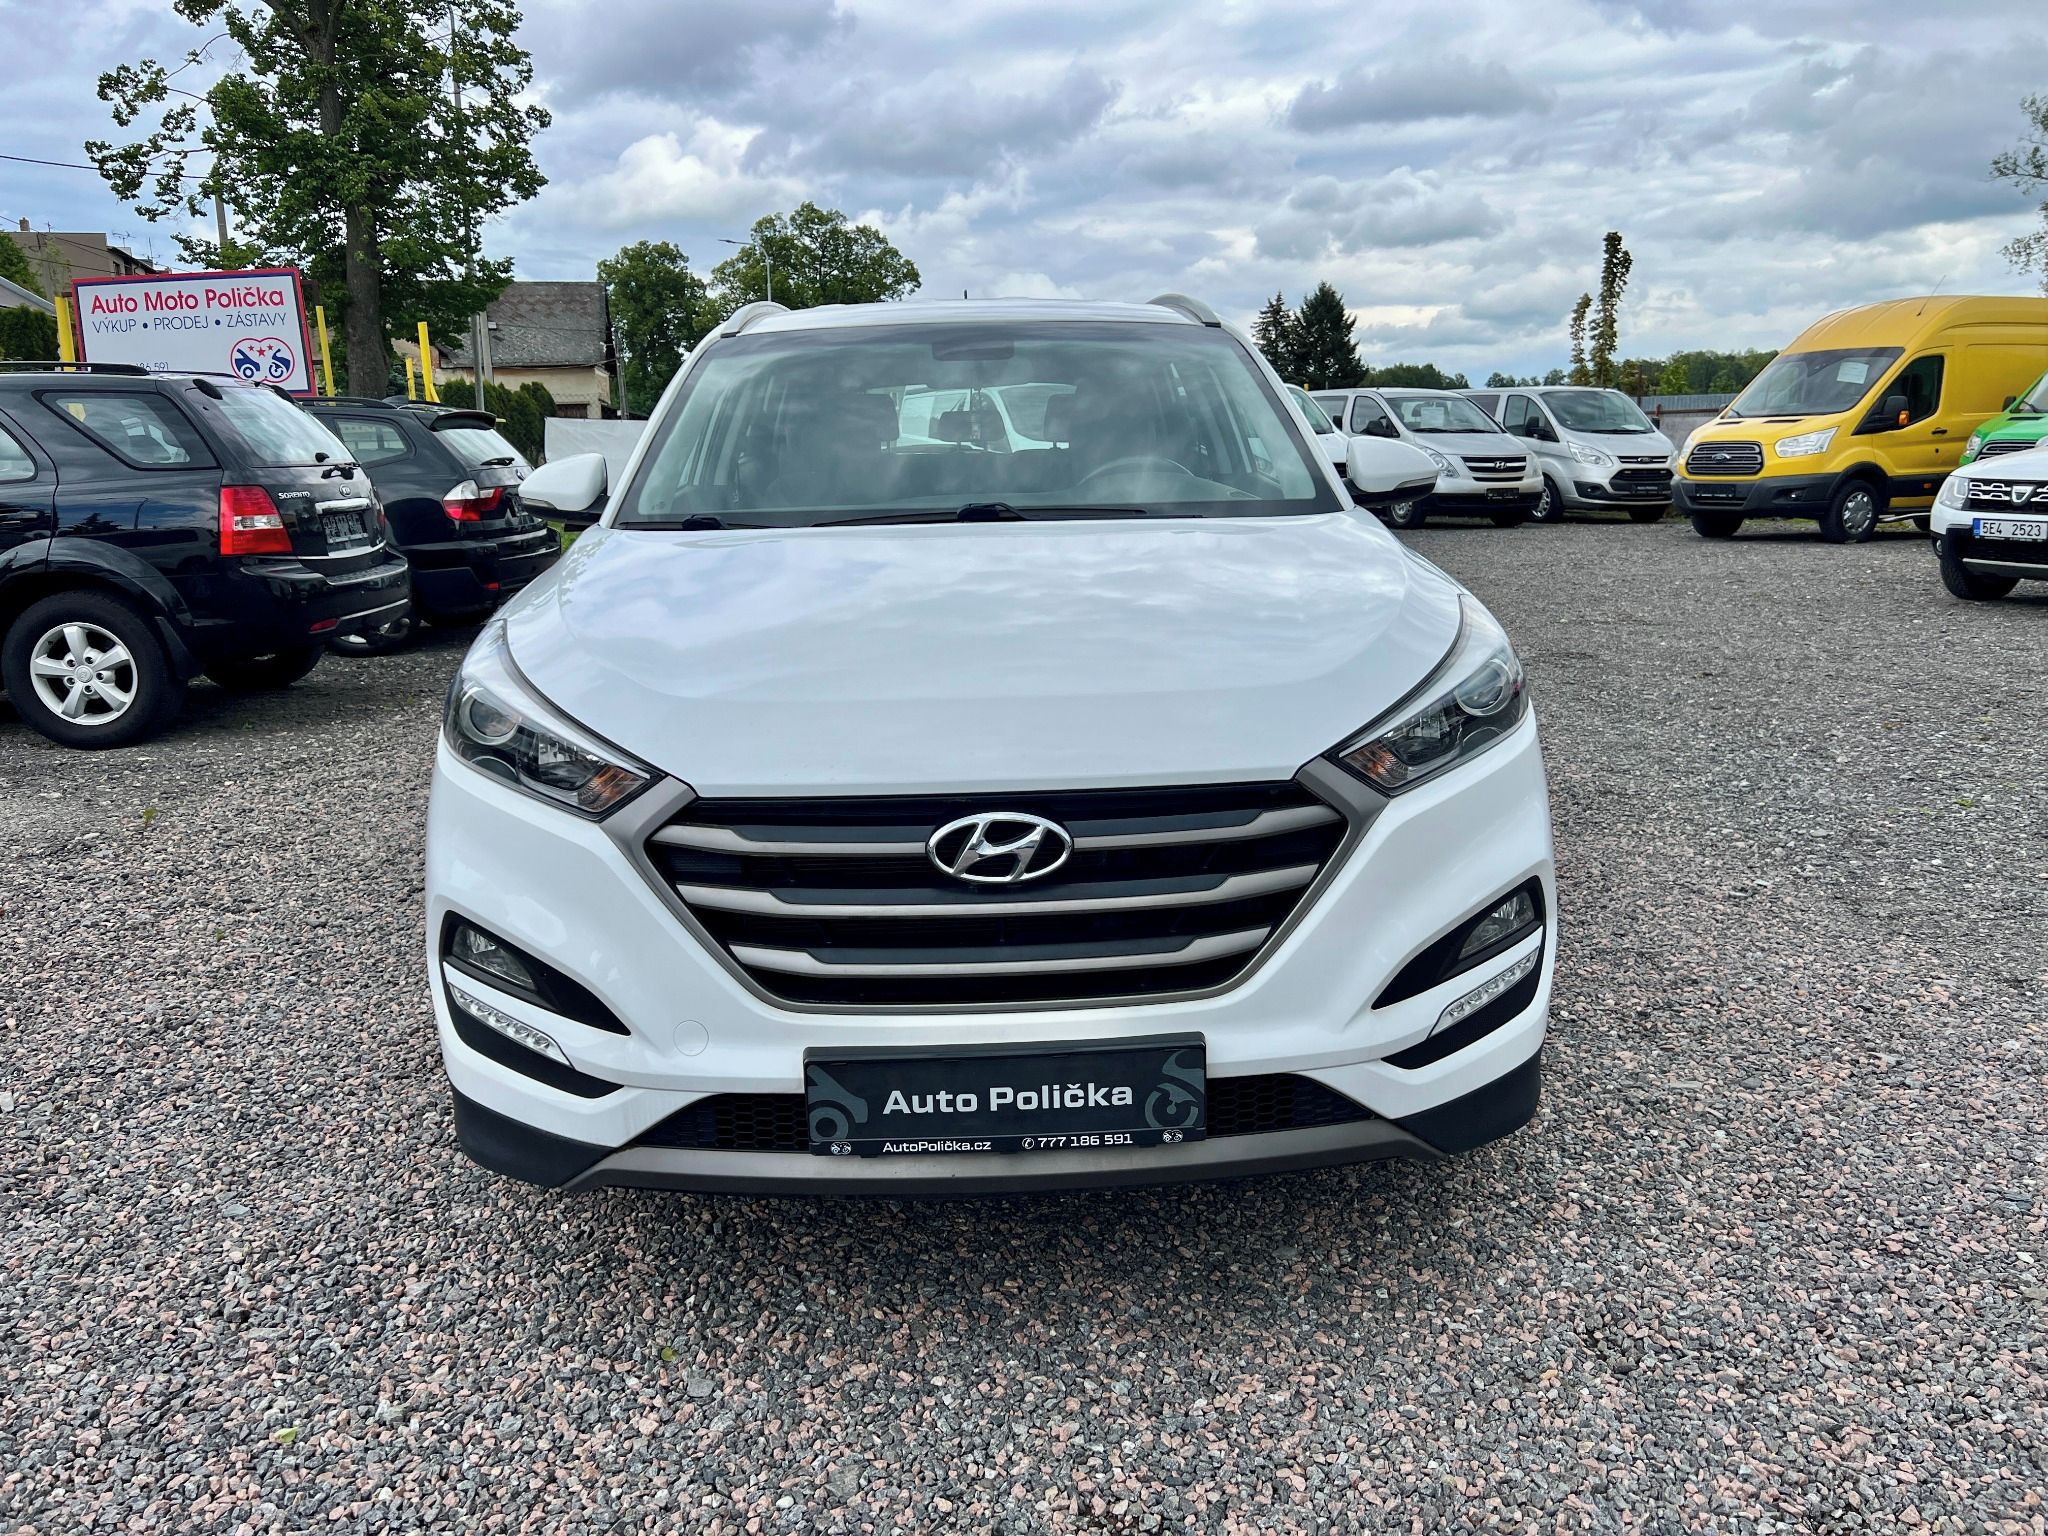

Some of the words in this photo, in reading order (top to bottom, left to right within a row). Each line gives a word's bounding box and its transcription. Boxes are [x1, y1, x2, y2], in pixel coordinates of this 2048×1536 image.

[91, 293, 138, 315] Auto
[144, 291, 199, 312] Moto
[204, 286, 285, 309] Polička
[92, 318, 137, 334] VÝKUP
[154, 315, 209, 331] PRODEJ
[226, 310, 287, 329] ZÁSTAVY
[1982, 522, 2002, 535] 5E4
[2011, 523, 2041, 537] 2523
[882, 1089, 978, 1115] Auto
[989, 1082, 1133, 1112] Polička
[882, 1140, 992, 1153] AutoPolička.cz
[1037, 1136, 1067, 1148] 777
[1070, 1135, 1100, 1147] 186
[1104, 1133, 1134, 1145] 591
